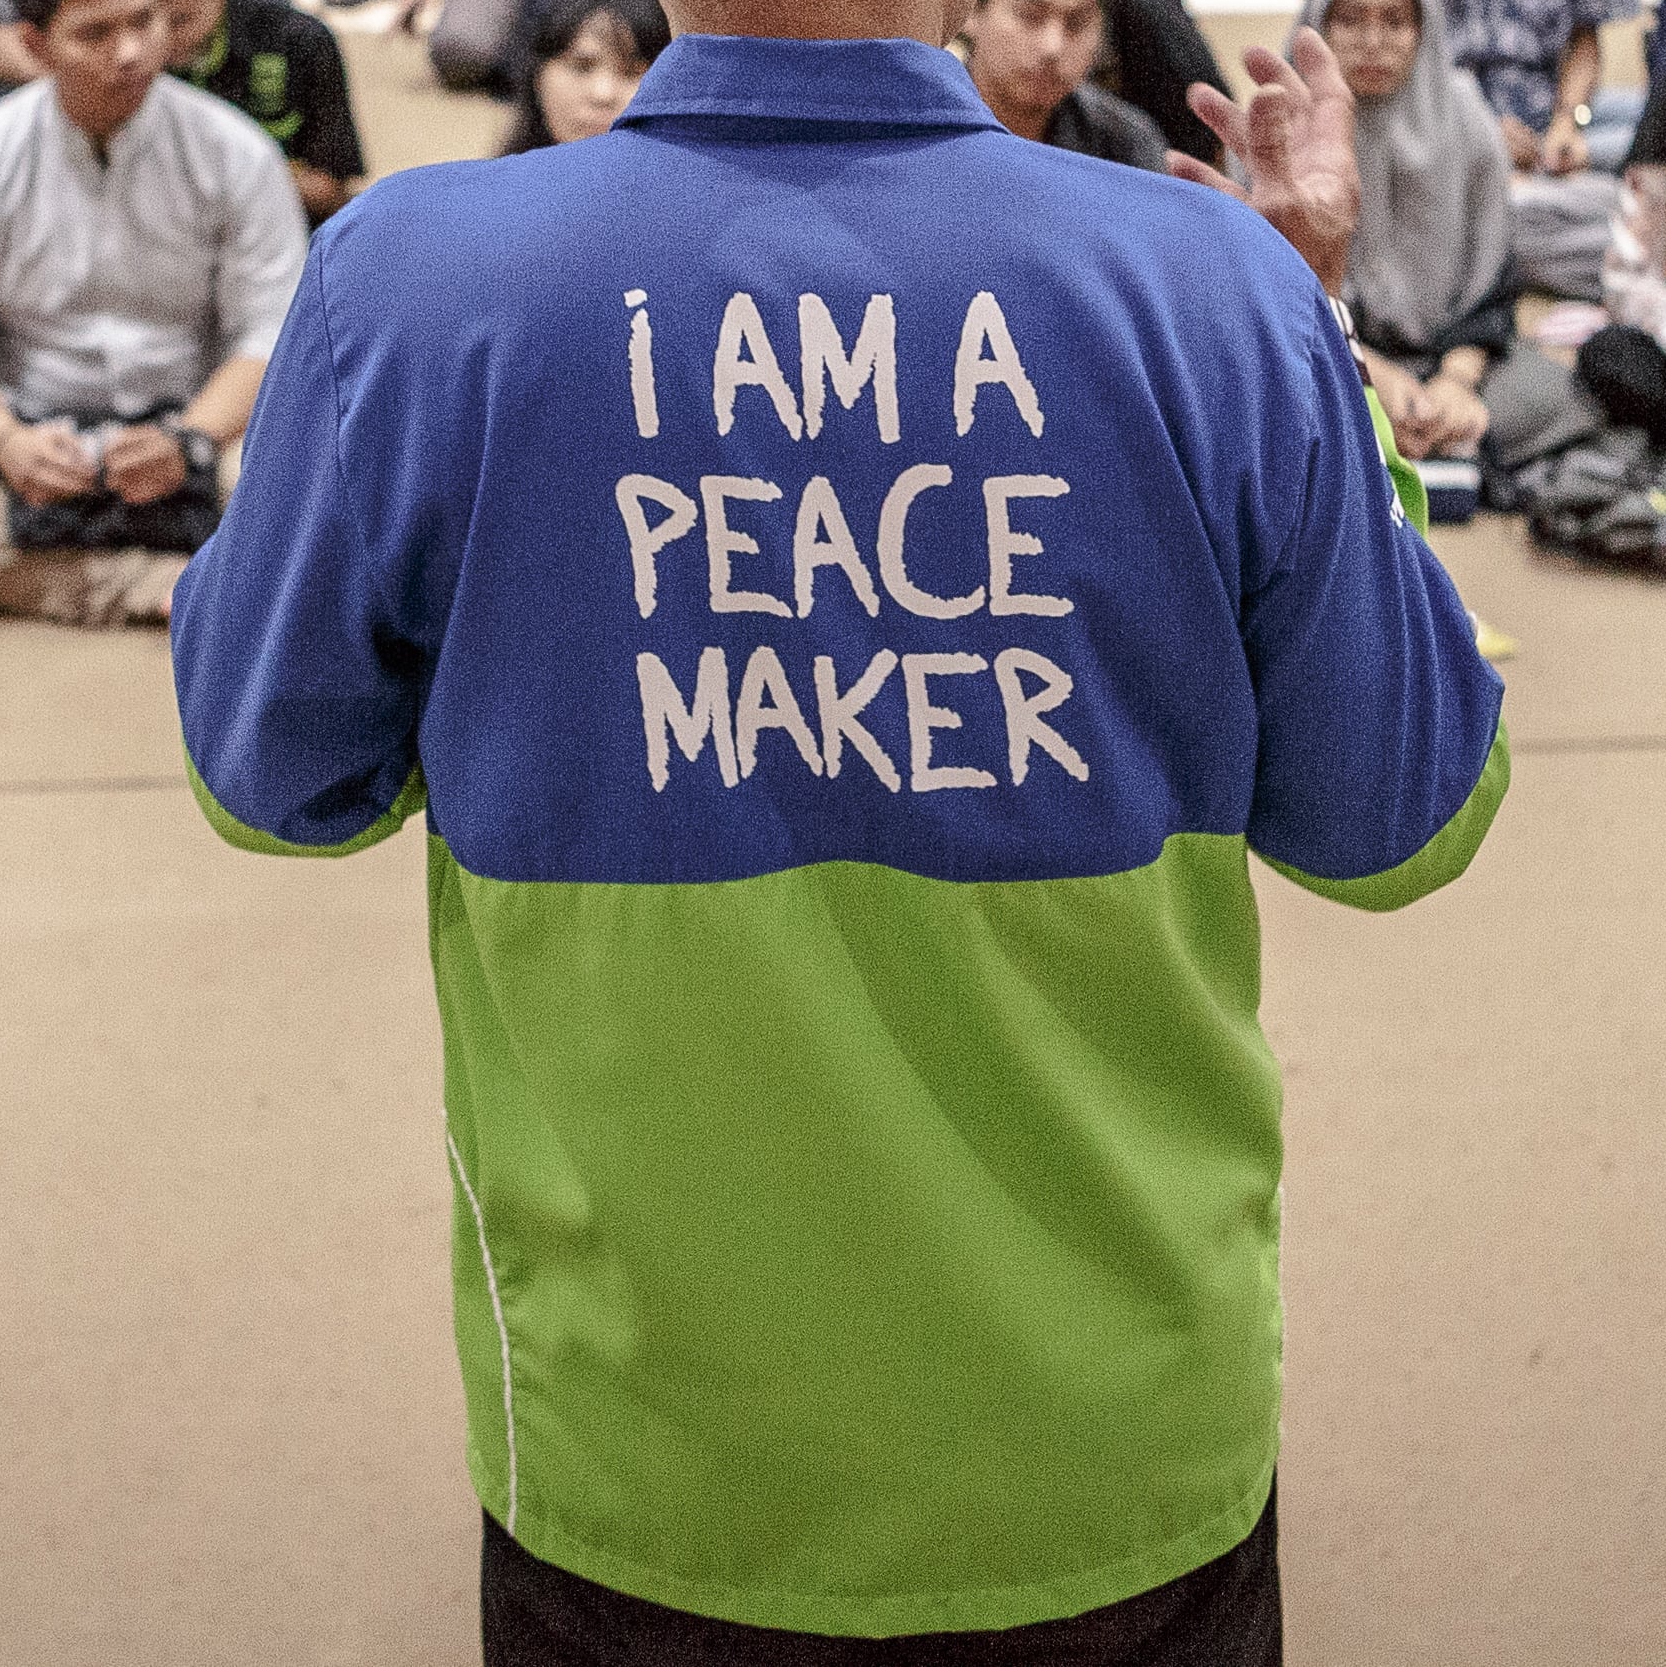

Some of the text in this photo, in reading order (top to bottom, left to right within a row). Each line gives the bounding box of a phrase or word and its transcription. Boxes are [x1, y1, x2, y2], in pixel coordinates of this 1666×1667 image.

[712, 291, 901, 444] AM
[953, 290, 1045, 438] A
[615, 463, 1074, 620] PEACE
[635, 646, 1090, 793] MAKER
